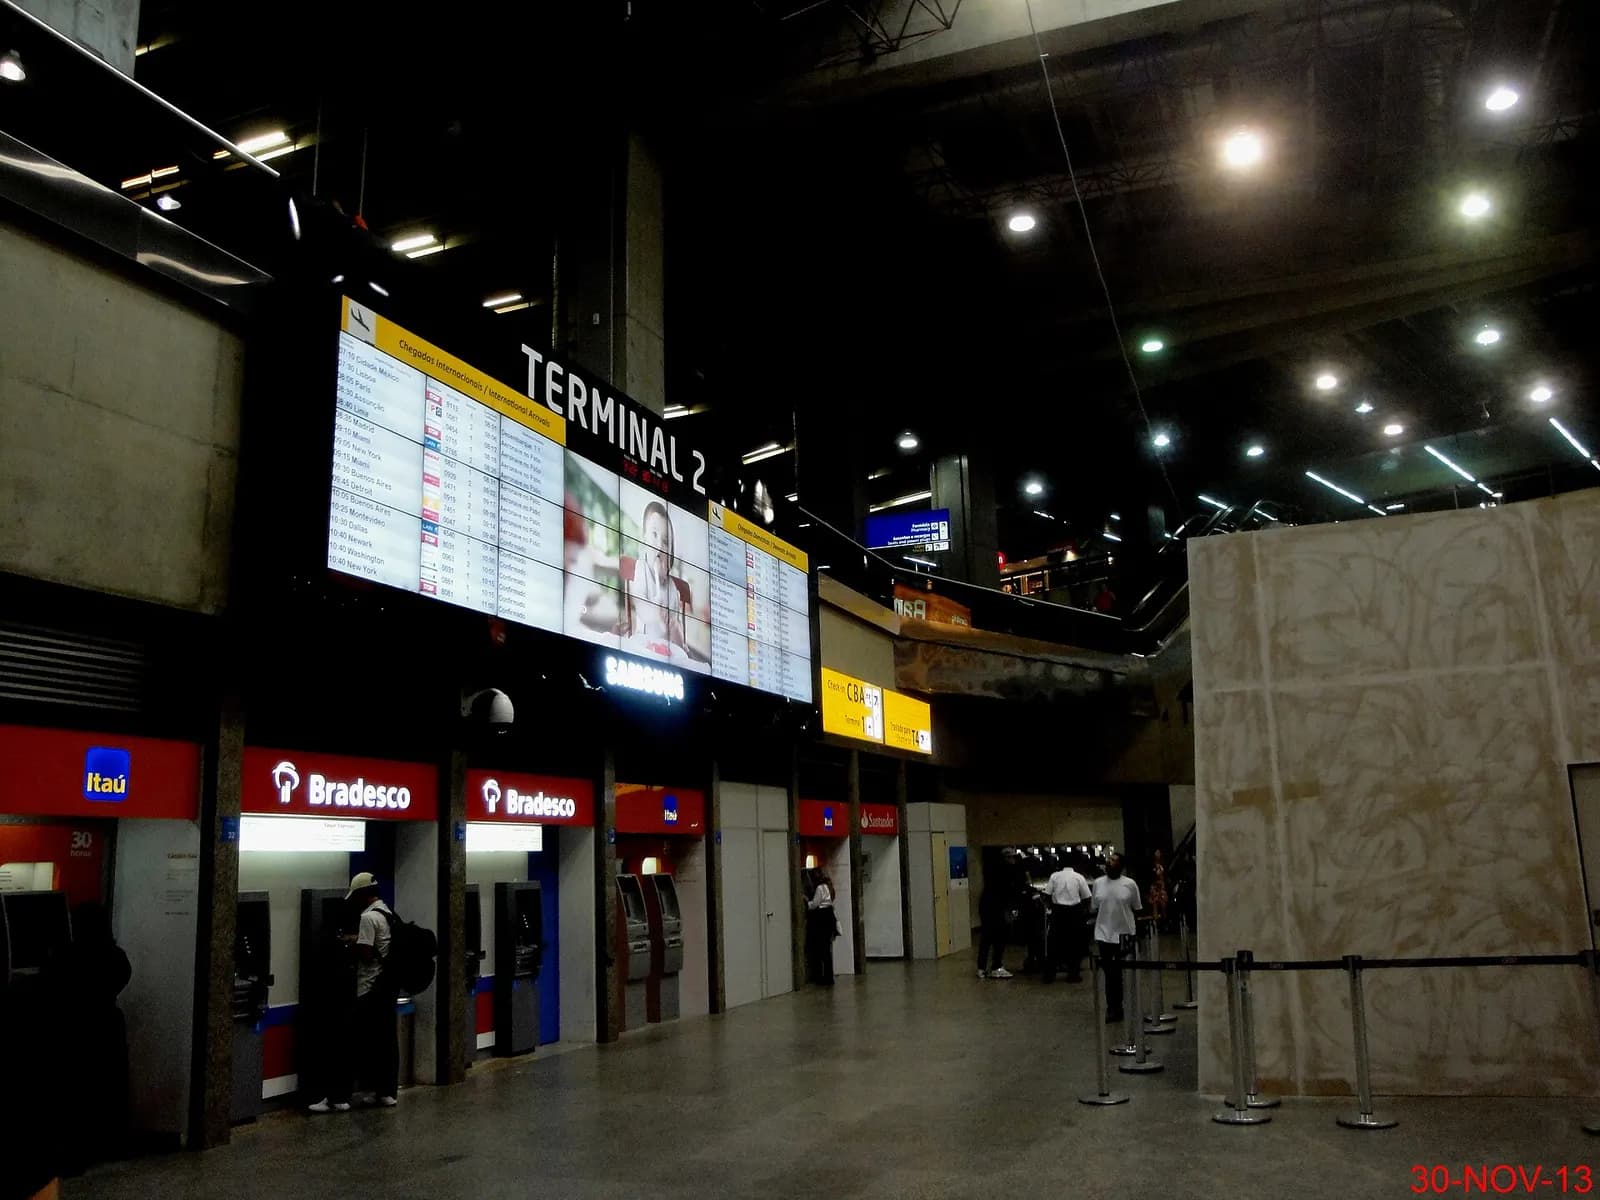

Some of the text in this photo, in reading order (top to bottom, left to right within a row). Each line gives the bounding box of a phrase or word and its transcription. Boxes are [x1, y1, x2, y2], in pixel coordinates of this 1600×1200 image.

[355, 380, 370, 393] Paris
[399, 339, 435, 365] Chegadas
[436, 359, 483, 392] Internacionais
[484, 385, 488, 394] /
[489, 389, 527, 416] International
[528, 410, 550, 428] Arrivals
[354, 405, 368, 417] Lima
[521, 343, 683, 482] TERMINAL
[692, 450, 705, 495] 2
[350, 482, 373, 496] Detroit
[351, 469, 376, 484] Buenos
[376, 479, 392, 491] Aires
[350, 495, 375, 510] Buenos
[349, 508, 385, 527] Montevideo
[330, 528, 347, 540] 10:40
[348, 534, 372, 548] Newark
[329, 541, 346, 553] 10:40
[347, 548, 384, 565] Washington
[329, 554, 346, 566] 10:40
[347, 561, 361, 572] New
[363, 565, 377, 576] York
[606, 656, 684, 700] SAMSUNG
[87, 772, 126, 793] Itaú
[310, 774, 411, 808] Bradesco
[507, 789, 576, 817] Bradesco
[72, 832, 92, 849] 30
